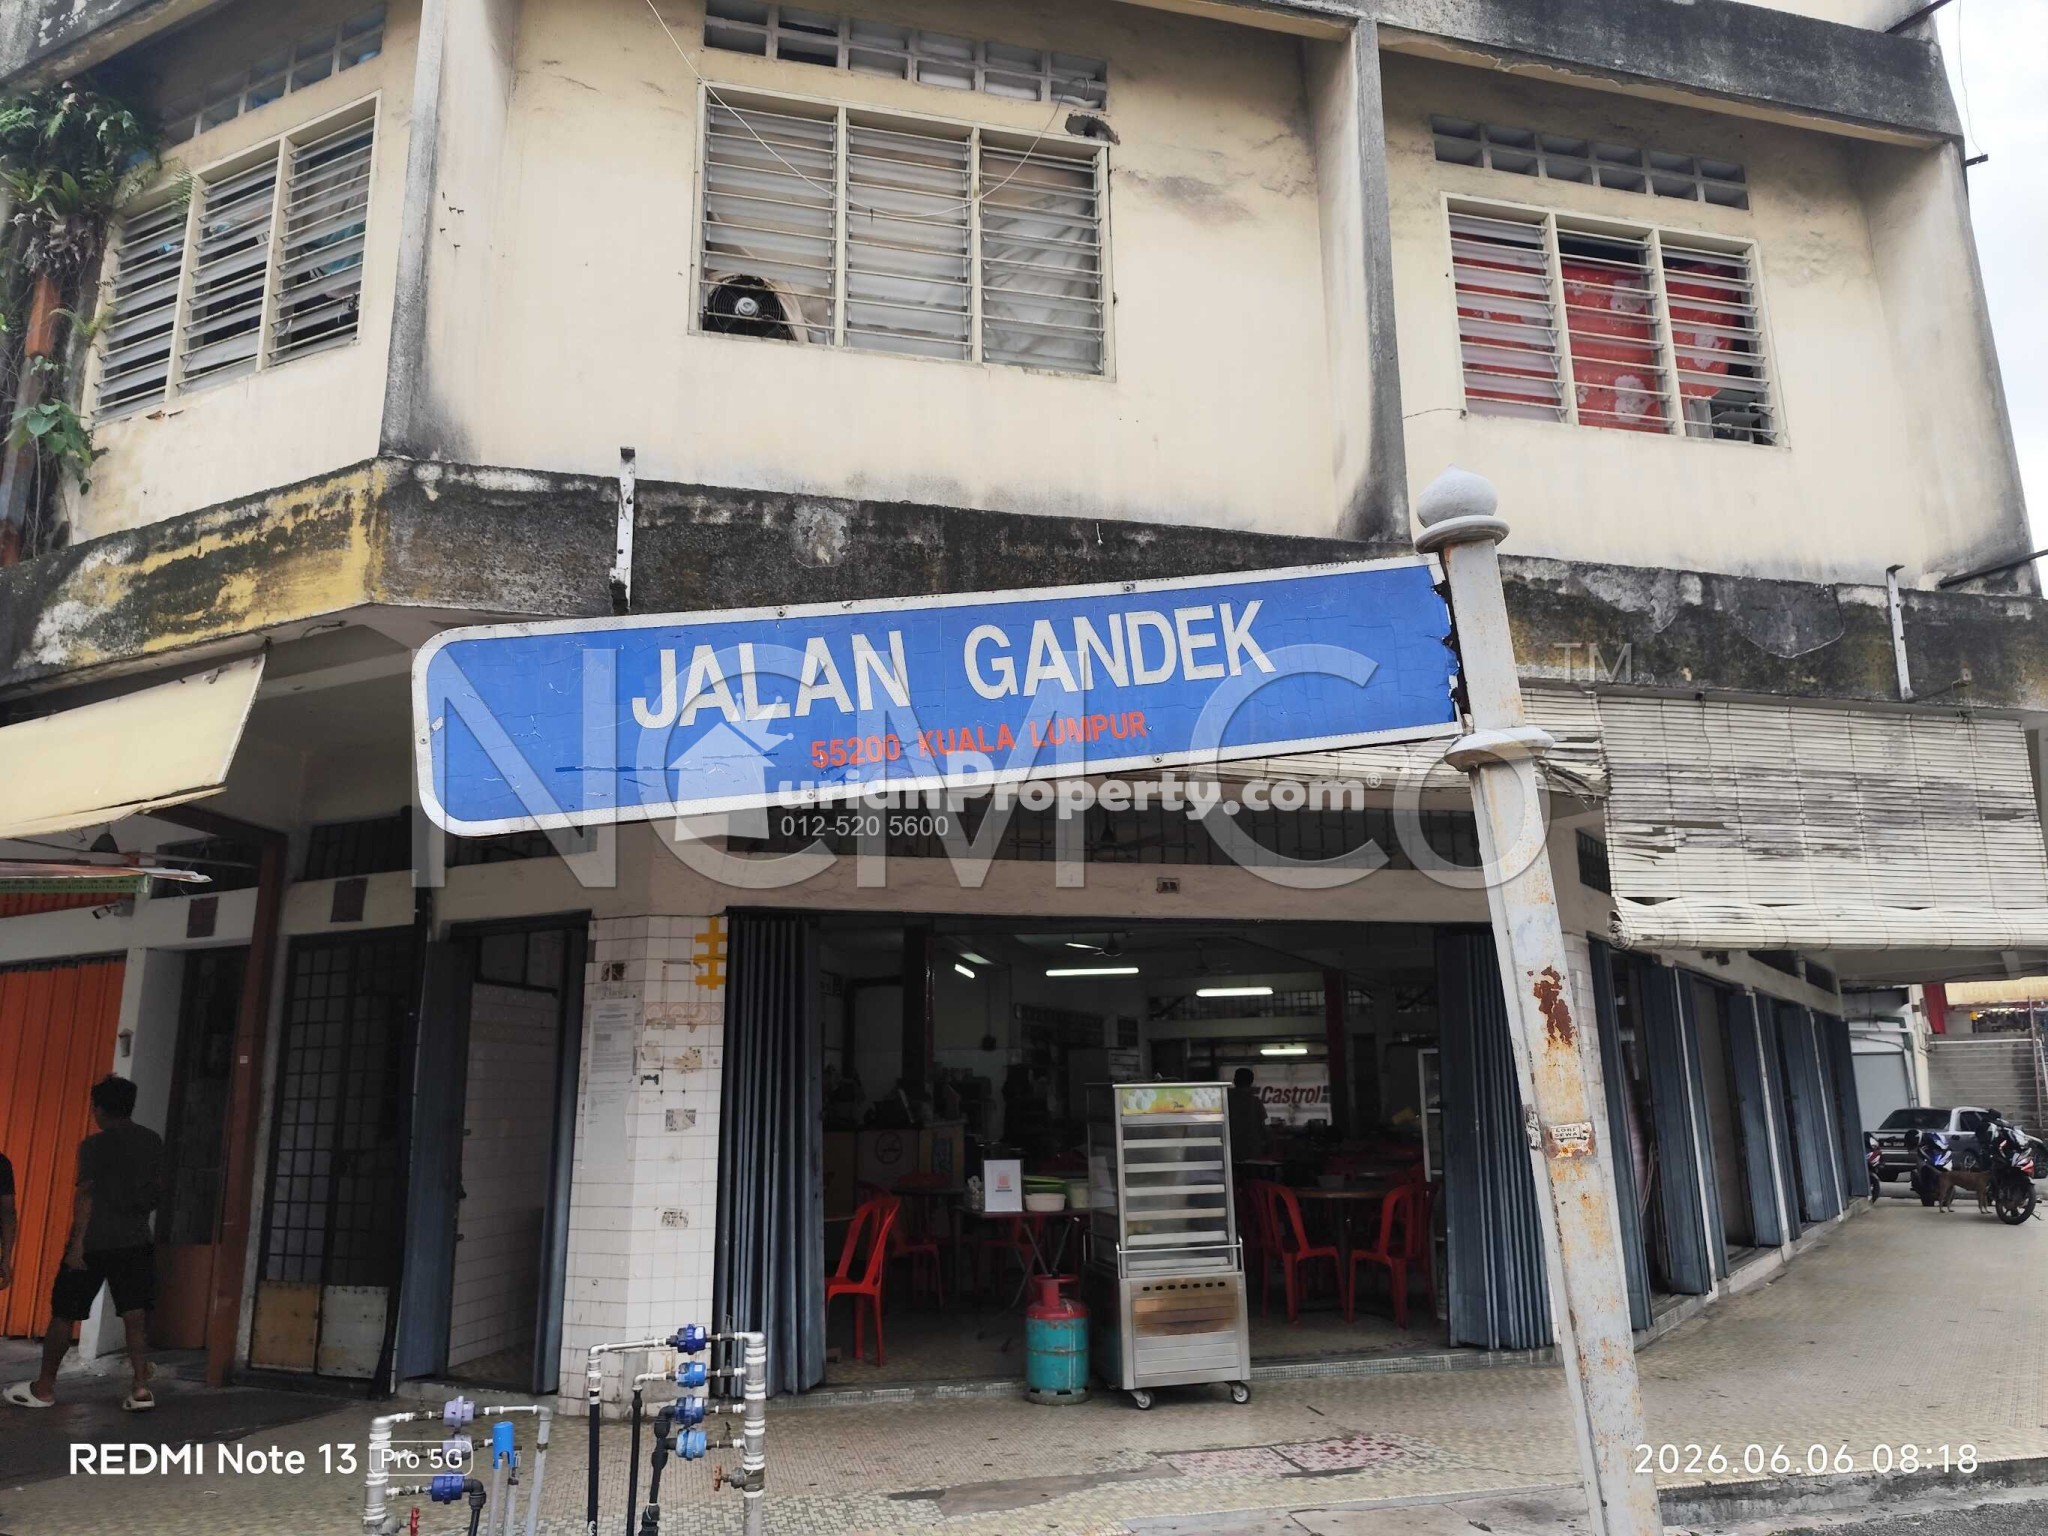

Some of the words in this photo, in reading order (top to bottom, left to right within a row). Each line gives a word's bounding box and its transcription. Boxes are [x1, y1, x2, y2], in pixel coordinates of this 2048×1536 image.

[631, 630, 911, 730] JALAN
[963, 600, 1277, 700] GANDEK
[811, 734, 902, 769] 55200
[919, 726, 1016, 758] KUALA
[1030, 710, 1147, 748] LUMPUR
[1261, 1086, 1321, 1104] Castrol
